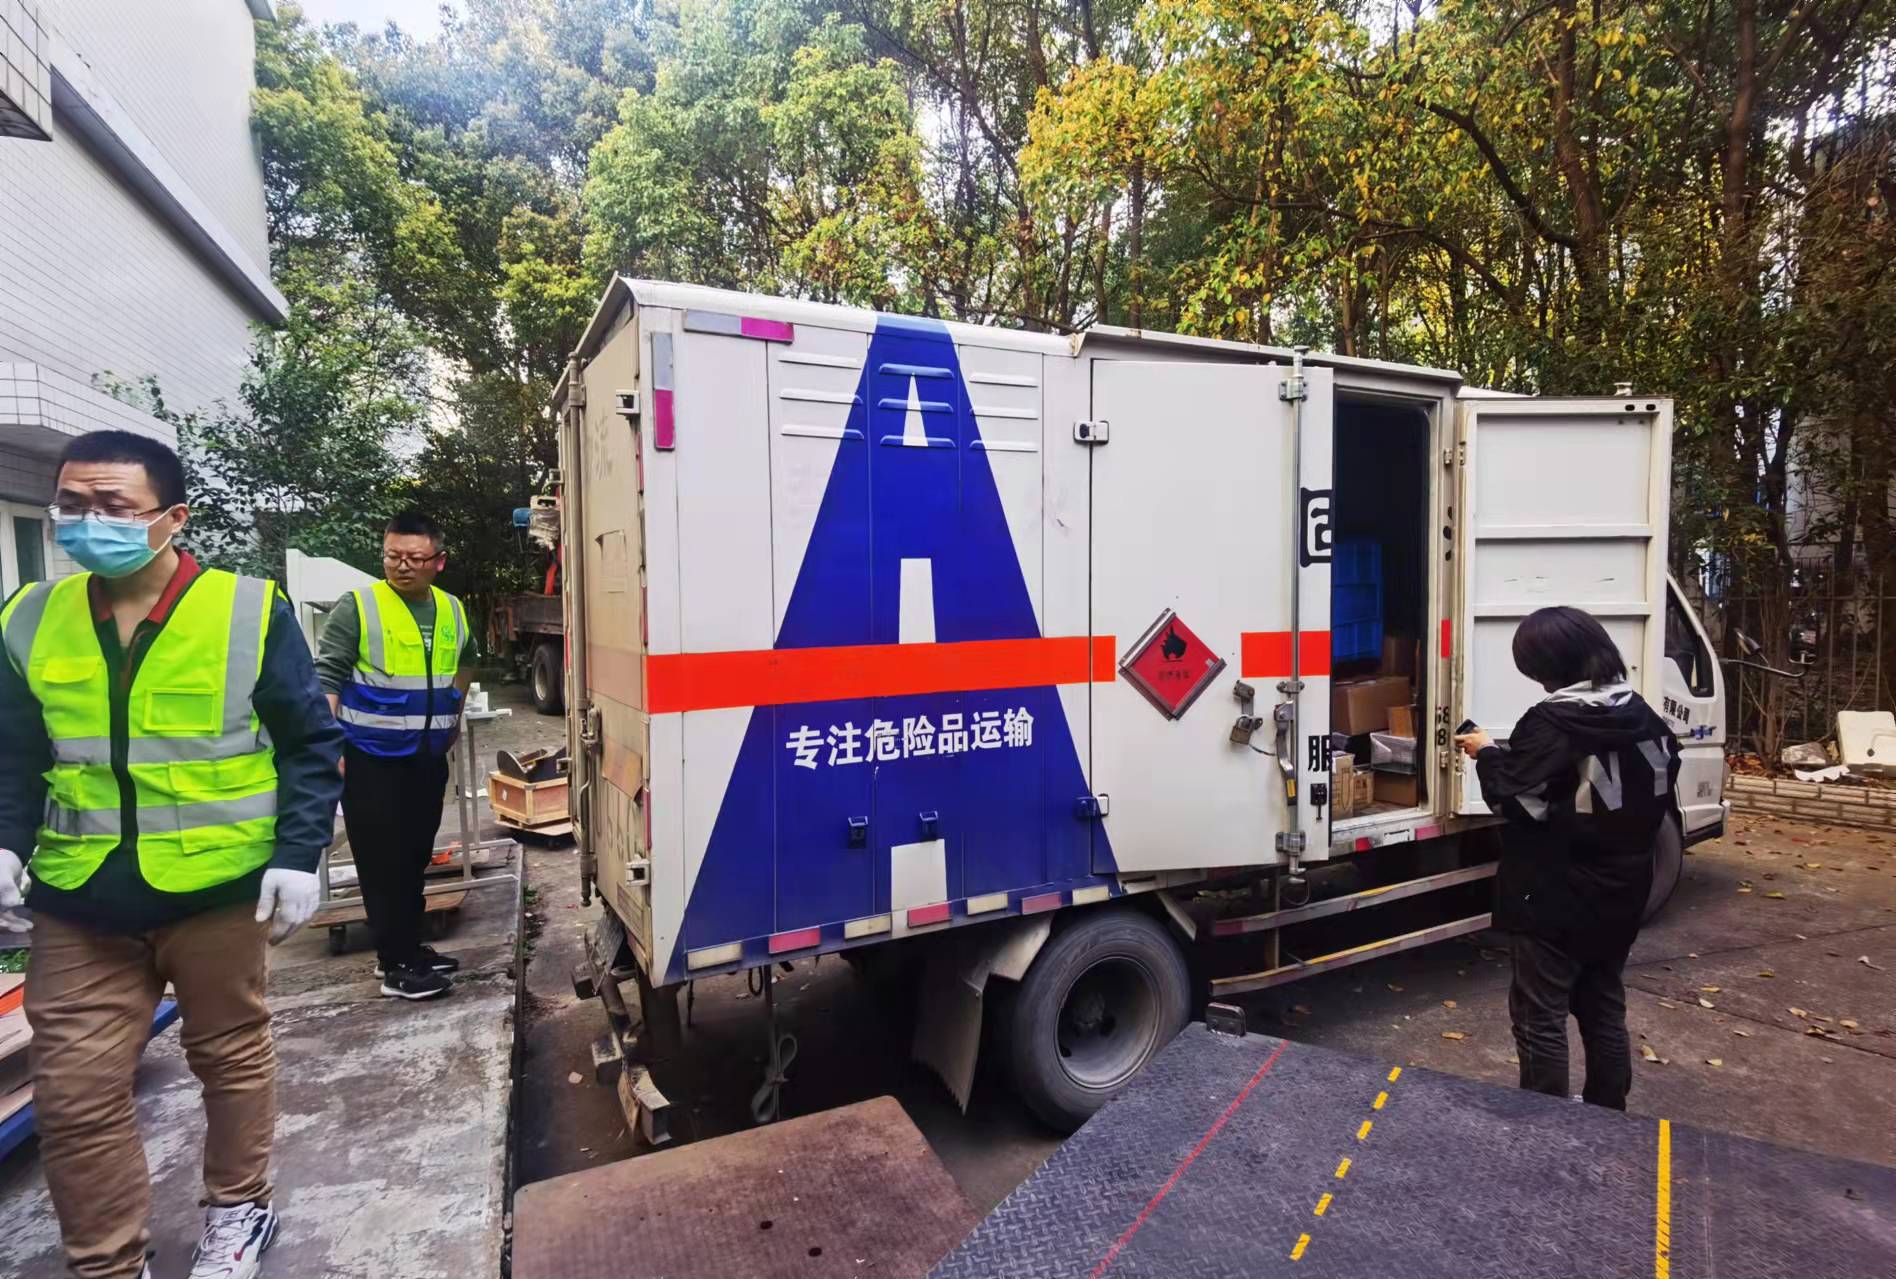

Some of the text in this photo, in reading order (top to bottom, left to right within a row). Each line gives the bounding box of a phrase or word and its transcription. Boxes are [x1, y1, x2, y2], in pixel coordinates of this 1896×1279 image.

[785, 706, 1034, 769] 专注危险品运输
